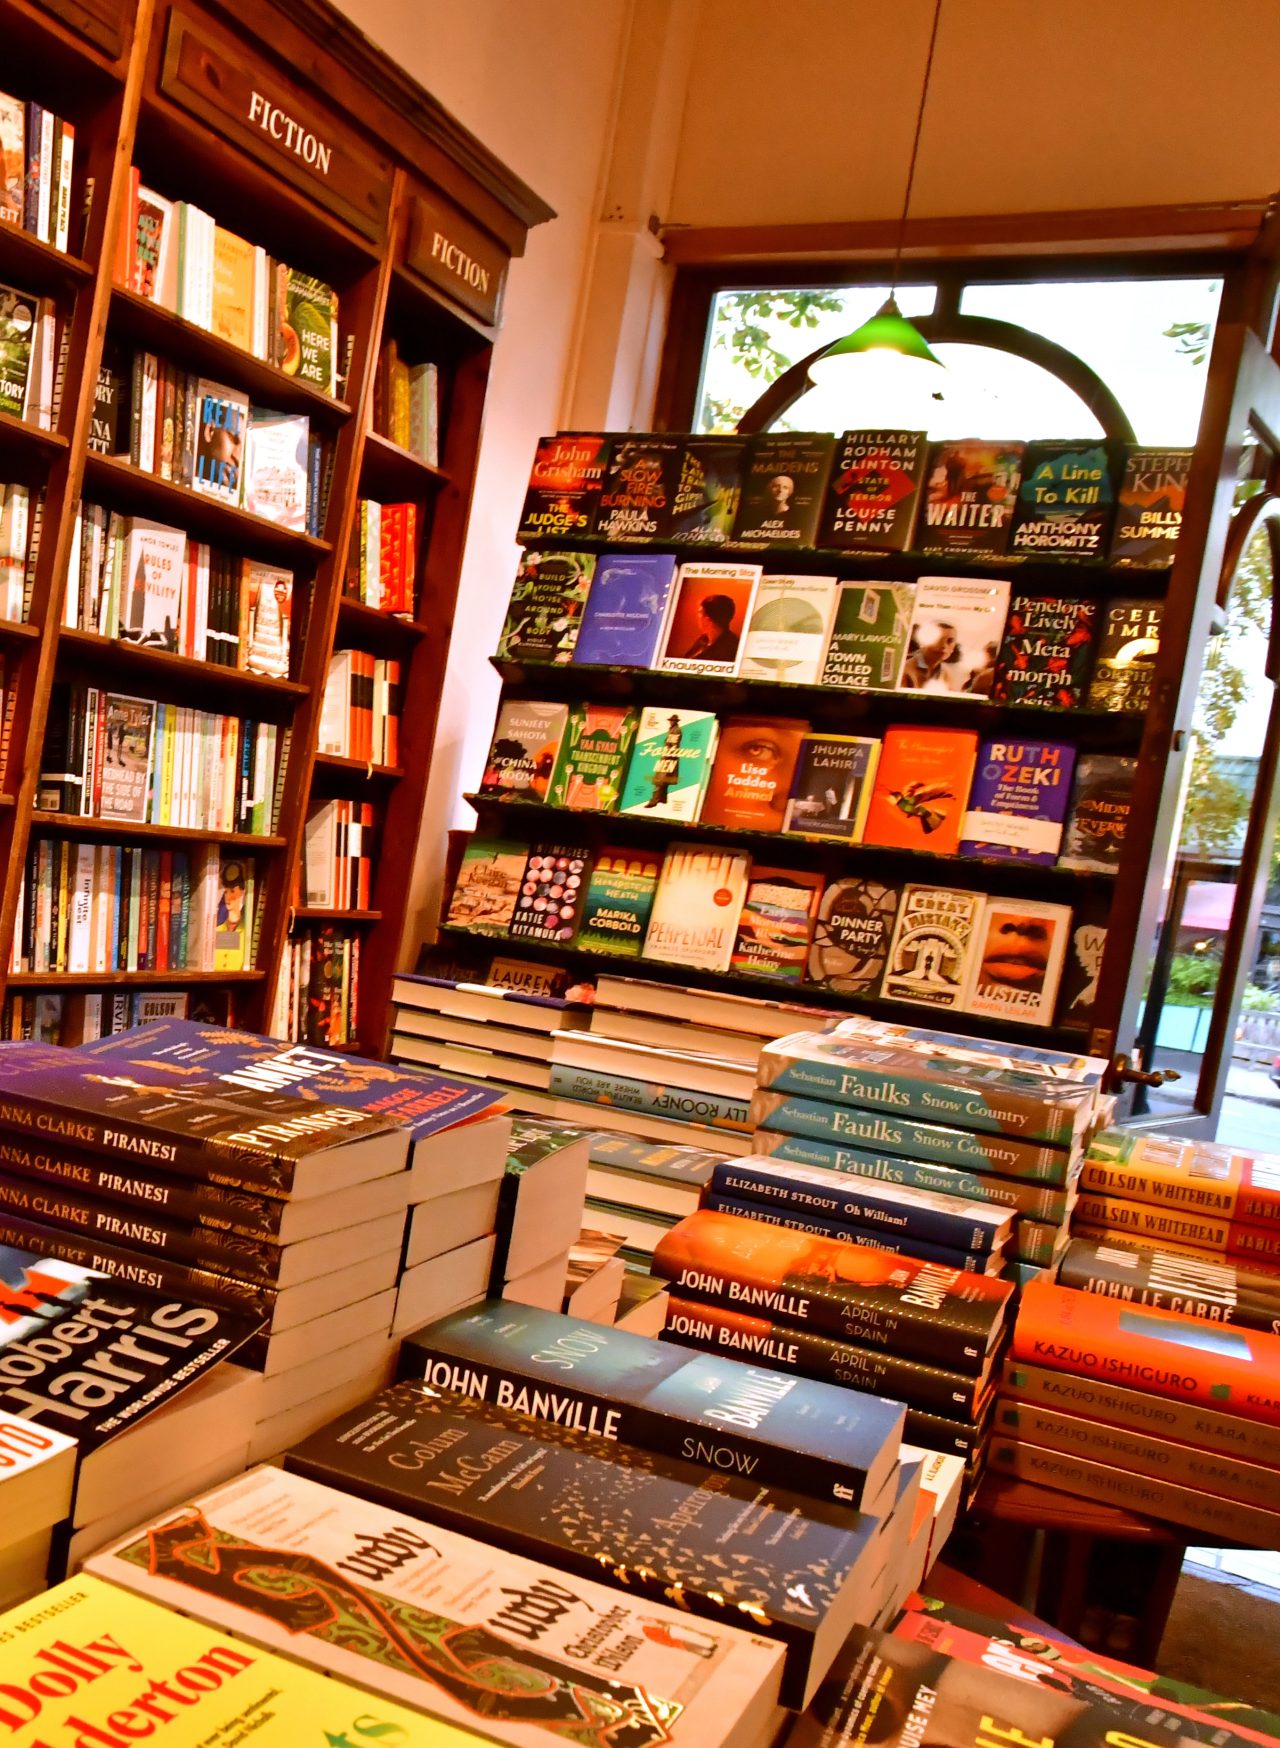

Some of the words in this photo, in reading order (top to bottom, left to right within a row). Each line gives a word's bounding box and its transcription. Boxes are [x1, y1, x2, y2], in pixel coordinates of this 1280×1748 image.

[247, 91, 331, 174] FICTION
[431, 232, 489, 293] FICTION
[302, 328, 329, 351] HERE
[301, 345, 318, 364] WE
[301, 363, 322, 381] ARE
[848, 434, 920, 445] HILLARY
[552, 445, 591, 462] John
[844, 446, 916, 457] RODHAM
[534, 464, 601, 480] Grisham
[840, 459, 915, 471] CLINTON
[1038, 466, 1051, 479] A
[1062, 466, 1101, 481] Line
[620, 470, 660, 482] SLOW
[601, 495, 666, 507] BURNING
[1035, 487, 1057, 503] To
[1066, 487, 1097, 504] Kill
[548, 504, 569, 514] THE
[610, 511, 648, 521] PAULA
[836, 508, 896, 520] LOUISE
[927, 504, 1004, 528] WAITER
[526, 514, 588, 527] JUDGE'S
[598, 521, 657, 532] HAWKINS
[834, 521, 893, 533] PENNY
[1017, 522, 1101, 536] ANTHONY
[1014, 534, 1099, 548] HOROWITZ
[1023, 613, 1076, 631] Lively
[829, 642, 839, 651] A
[1021, 639, 1071, 659] Meta
[661, 658, 734, 674] Knausgaard
[828, 652, 866, 664] TOWN
[825, 663, 872, 675] CALLED
[1009, 670, 1072, 687] morph
[822, 674, 869, 686] SOLACE
[812, 745, 864, 758] JHUMPA
[990, 744, 1060, 766] RUTH
[814, 758, 857, 770] LAHIRI
[982, 765, 1060, 785] OZEKI
[515, 912, 543, 924] KATIE
[831, 915, 883, 932] DINNER
[512, 924, 561, 940] KITAMURA
[840, 930, 881, 944] PARTY
[977, 984, 1042, 1007] LUSTER
[788, 1067, 837, 1093] Sebastian
[840, 1075, 911, 1108] Faulks
[922, 1091, 965, 1112] Snow
[966, 1099, 1029, 1129] Country
[228, 1108, 372, 1149] PIRANESI
[36, 1115, 94, 1142] CLARKE
[103, 1130, 176, 1162] PIRANESI
[33, 1155, 92, 1182] CLARKE
[99, 1172, 168, 1204] PIRANESI
[833, 1147, 904, 1184] Faulks
[914, 1170, 960, 1192] Snow
[959, 1176, 1020, 1206] Country
[1087, 1168, 1146, 1194] COLSON
[1151, 1178, 1232, 1211] WHITEHEAD
[725, 1175, 788, 1201] ELIZABETH
[791, 1189, 838, 1211] STROUT
[844, 1203, 863, 1217] Oh
[864, 1205, 907, 1228] William!
[96, 1212, 167, 1246] PIRANESI
[92, 1254, 163, 1289] PIRANESI
[677, 1269, 724, 1295] JOHN
[729, 1282, 809, 1318] BANVILLE
[1082, 1278, 1131, 1303] JOHN
[1141, 1289, 1166, 1309] LE
[841, 1304, 880, 1326] APRIL
[666, 1315, 713, 1342] JOHN
[718, 1326, 798, 1363] BANVILLE
[844, 1324, 888, 1344] SPAIN
[531, 1329, 607, 1369] SNOW
[4, 1303, 218, 1420] Harris
[1034, 1341, 1097, 1368] KAZUO
[1101, 1356, 1198, 1392] ISHIGURO
[95, 1417, 121, 1433] THE
[119, 1378, 178, 1420] WORLDWIDE
[173, 1339, 231, 1382] BESTSELLER
[425, 1359, 488, 1402] JOHN
[495, 1380, 621, 1440] BANVILLE
[388, 1428, 470, 1470] Colum
[682, 1438, 758, 1475] SNOW
[426, 1439, 523, 1497] McCann
[17, 1591, 90, 1633] BESTSELLER
